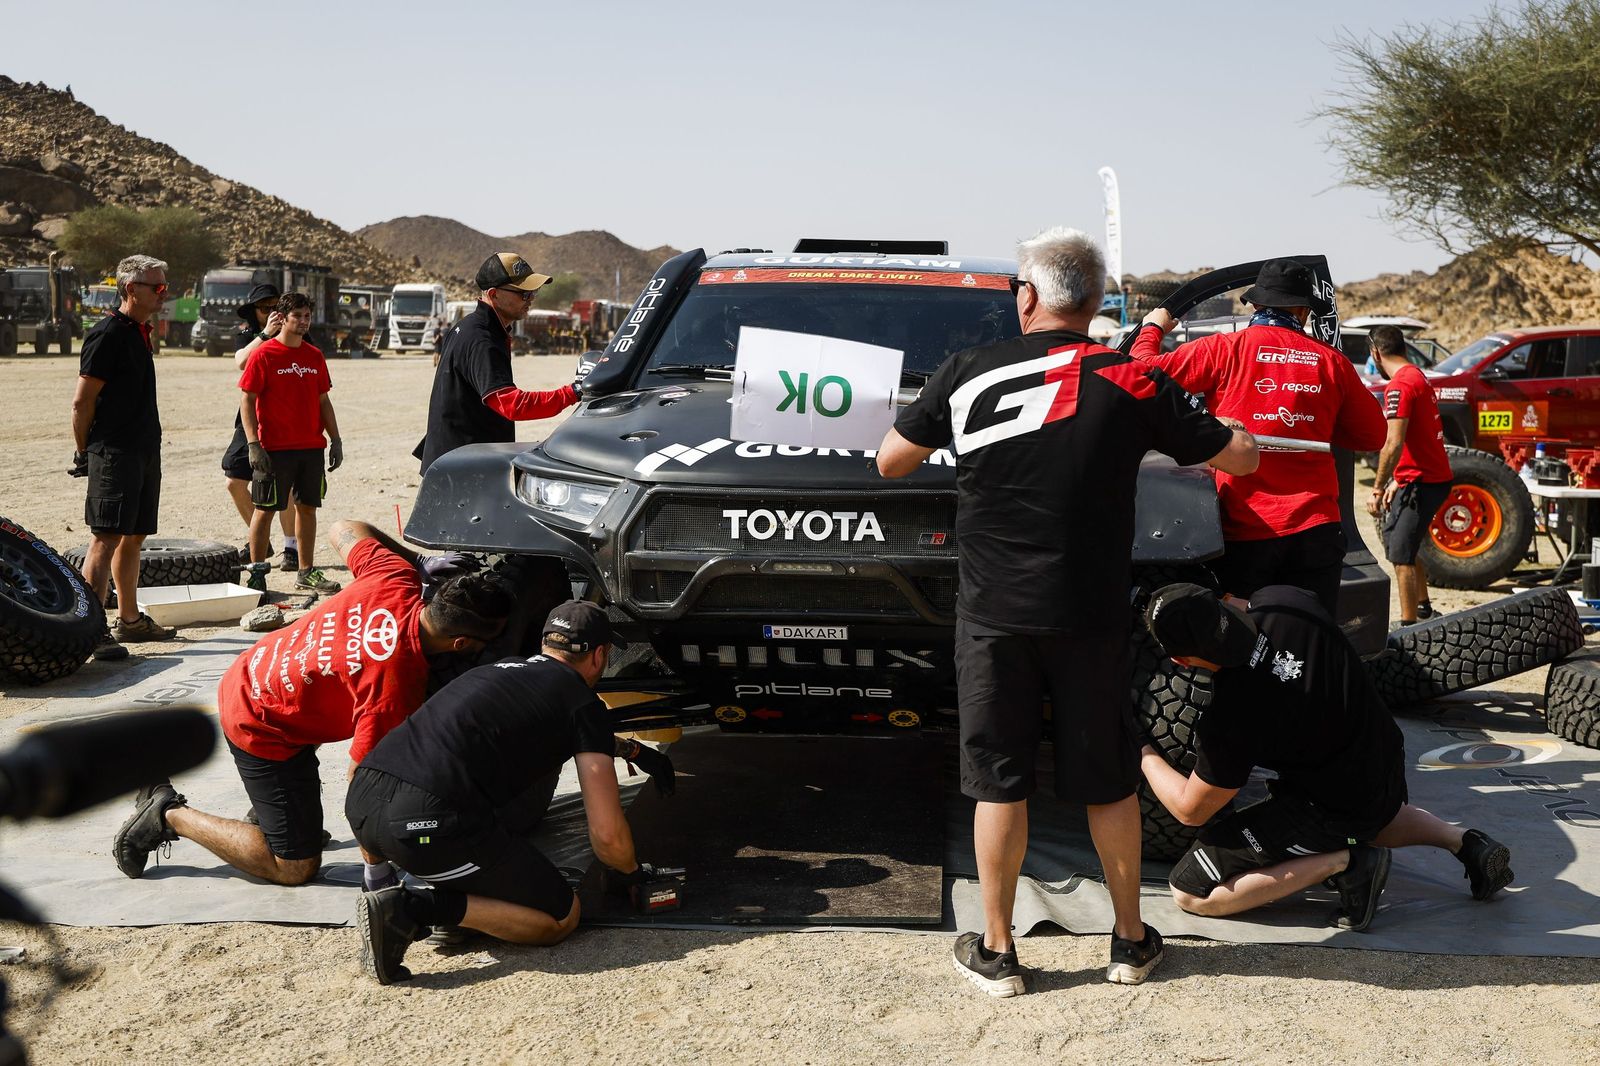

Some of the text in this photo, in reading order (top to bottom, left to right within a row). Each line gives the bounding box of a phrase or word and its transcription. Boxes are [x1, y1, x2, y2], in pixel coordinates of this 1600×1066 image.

[754, 256, 962, 269] GURTAM
[612, 278, 666, 353] pitlane
[1258, 352, 1286, 362] GR
[776, 370, 852, 418] OK
[1281, 383, 1321, 393] repsol
[1481, 414, 1510, 427] 1273
[734, 441, 957, 467] GUM
[722, 509, 885, 542] TOYOTA
[346, 603, 362, 677] TOYOTA
[783, 628, 844, 638] DAKAR1
[317, 612, 336, 677] HILUX
[734, 682, 893, 698] pitlane
[406, 820, 438, 830] sparco
[1241, 827, 1263, 853] sparco
